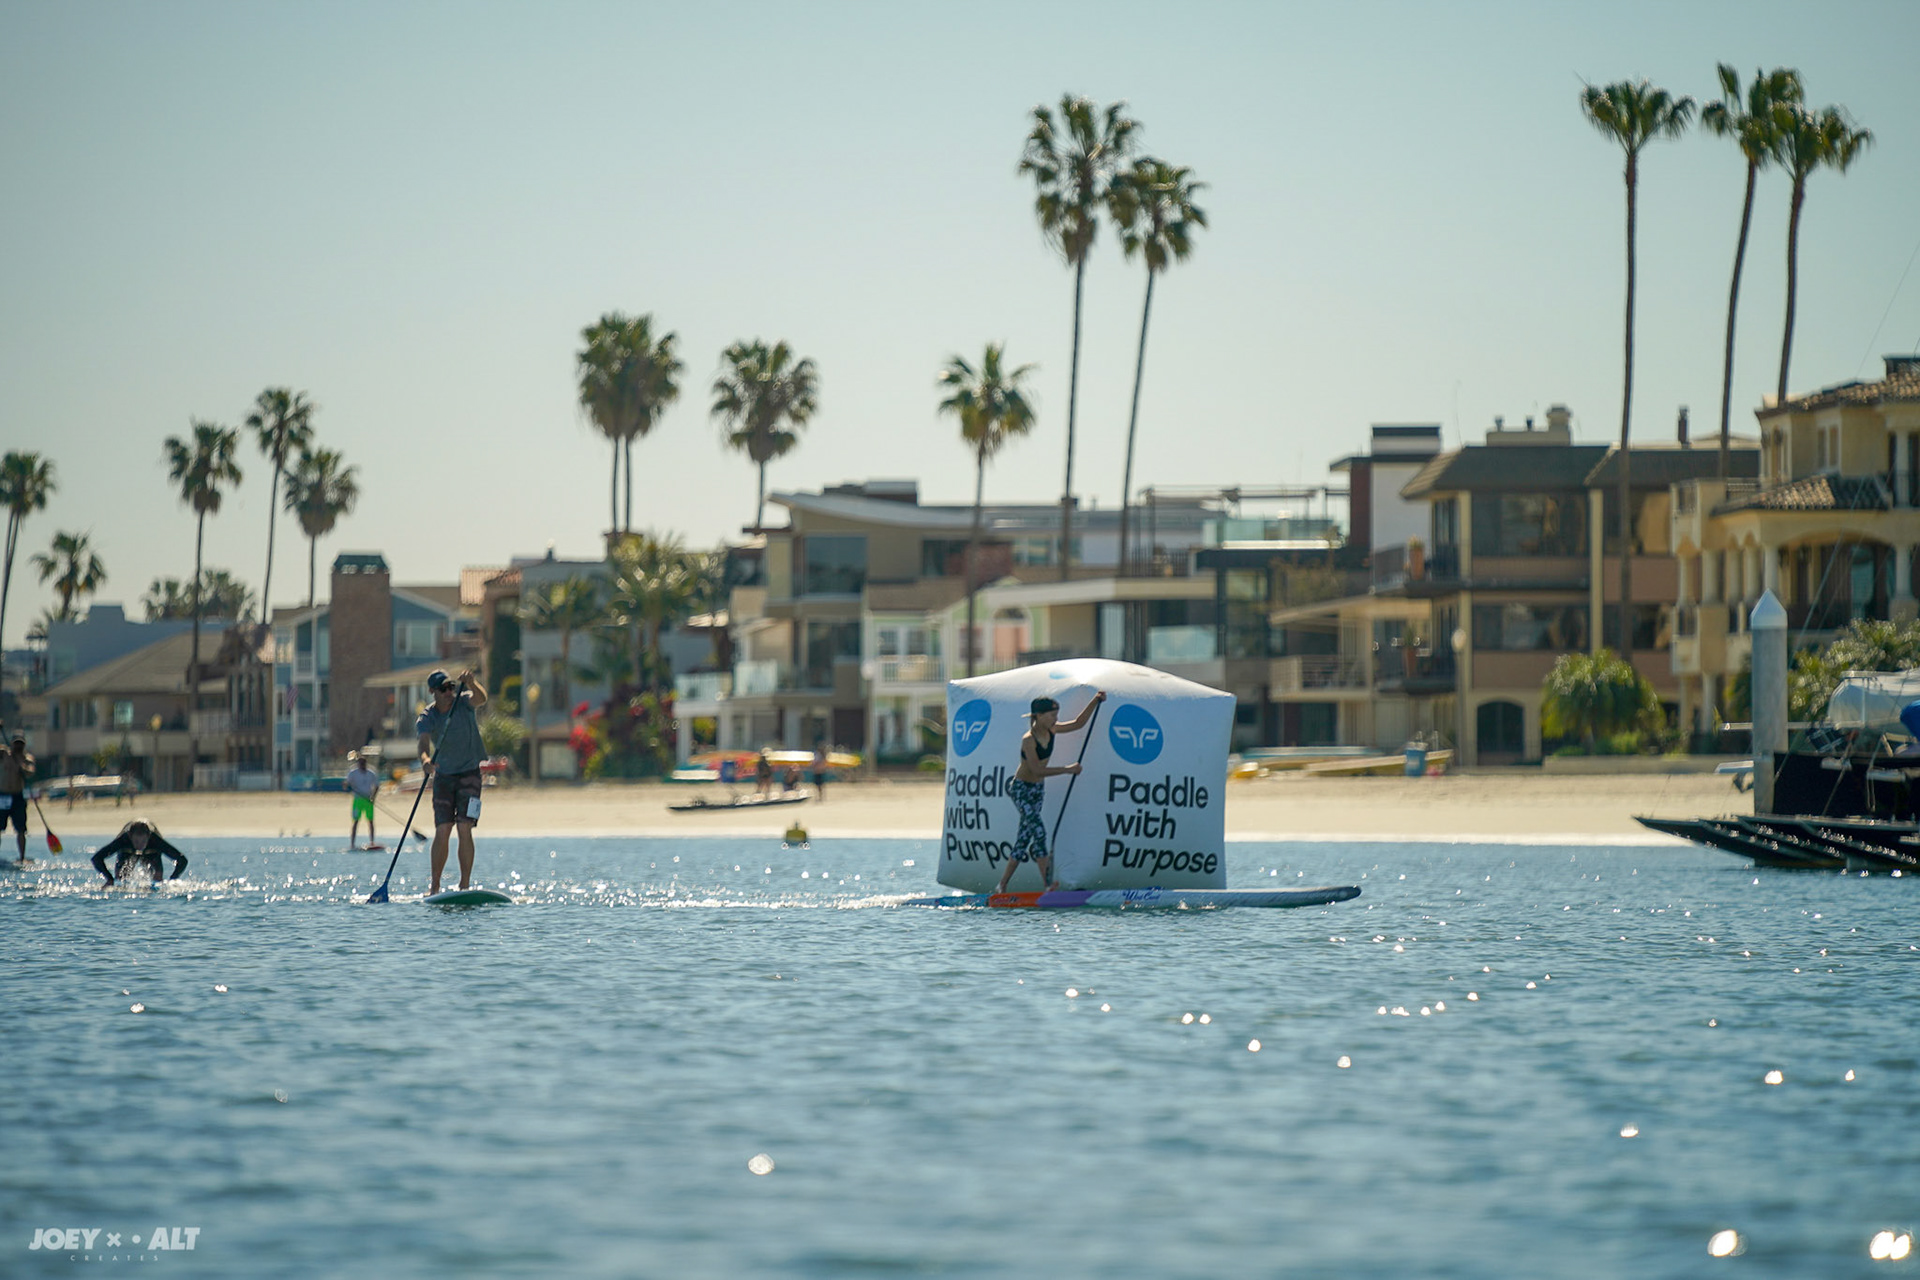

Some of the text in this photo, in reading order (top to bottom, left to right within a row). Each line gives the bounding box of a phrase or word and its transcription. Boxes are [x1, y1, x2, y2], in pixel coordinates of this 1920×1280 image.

[1108, 773, 1208, 808] Paddle
[946, 799, 990, 830] with
[1105, 808, 1177, 839] with
[946, 832, 1037, 869] Purpo
[1102, 839, 1218, 877] Purpose
